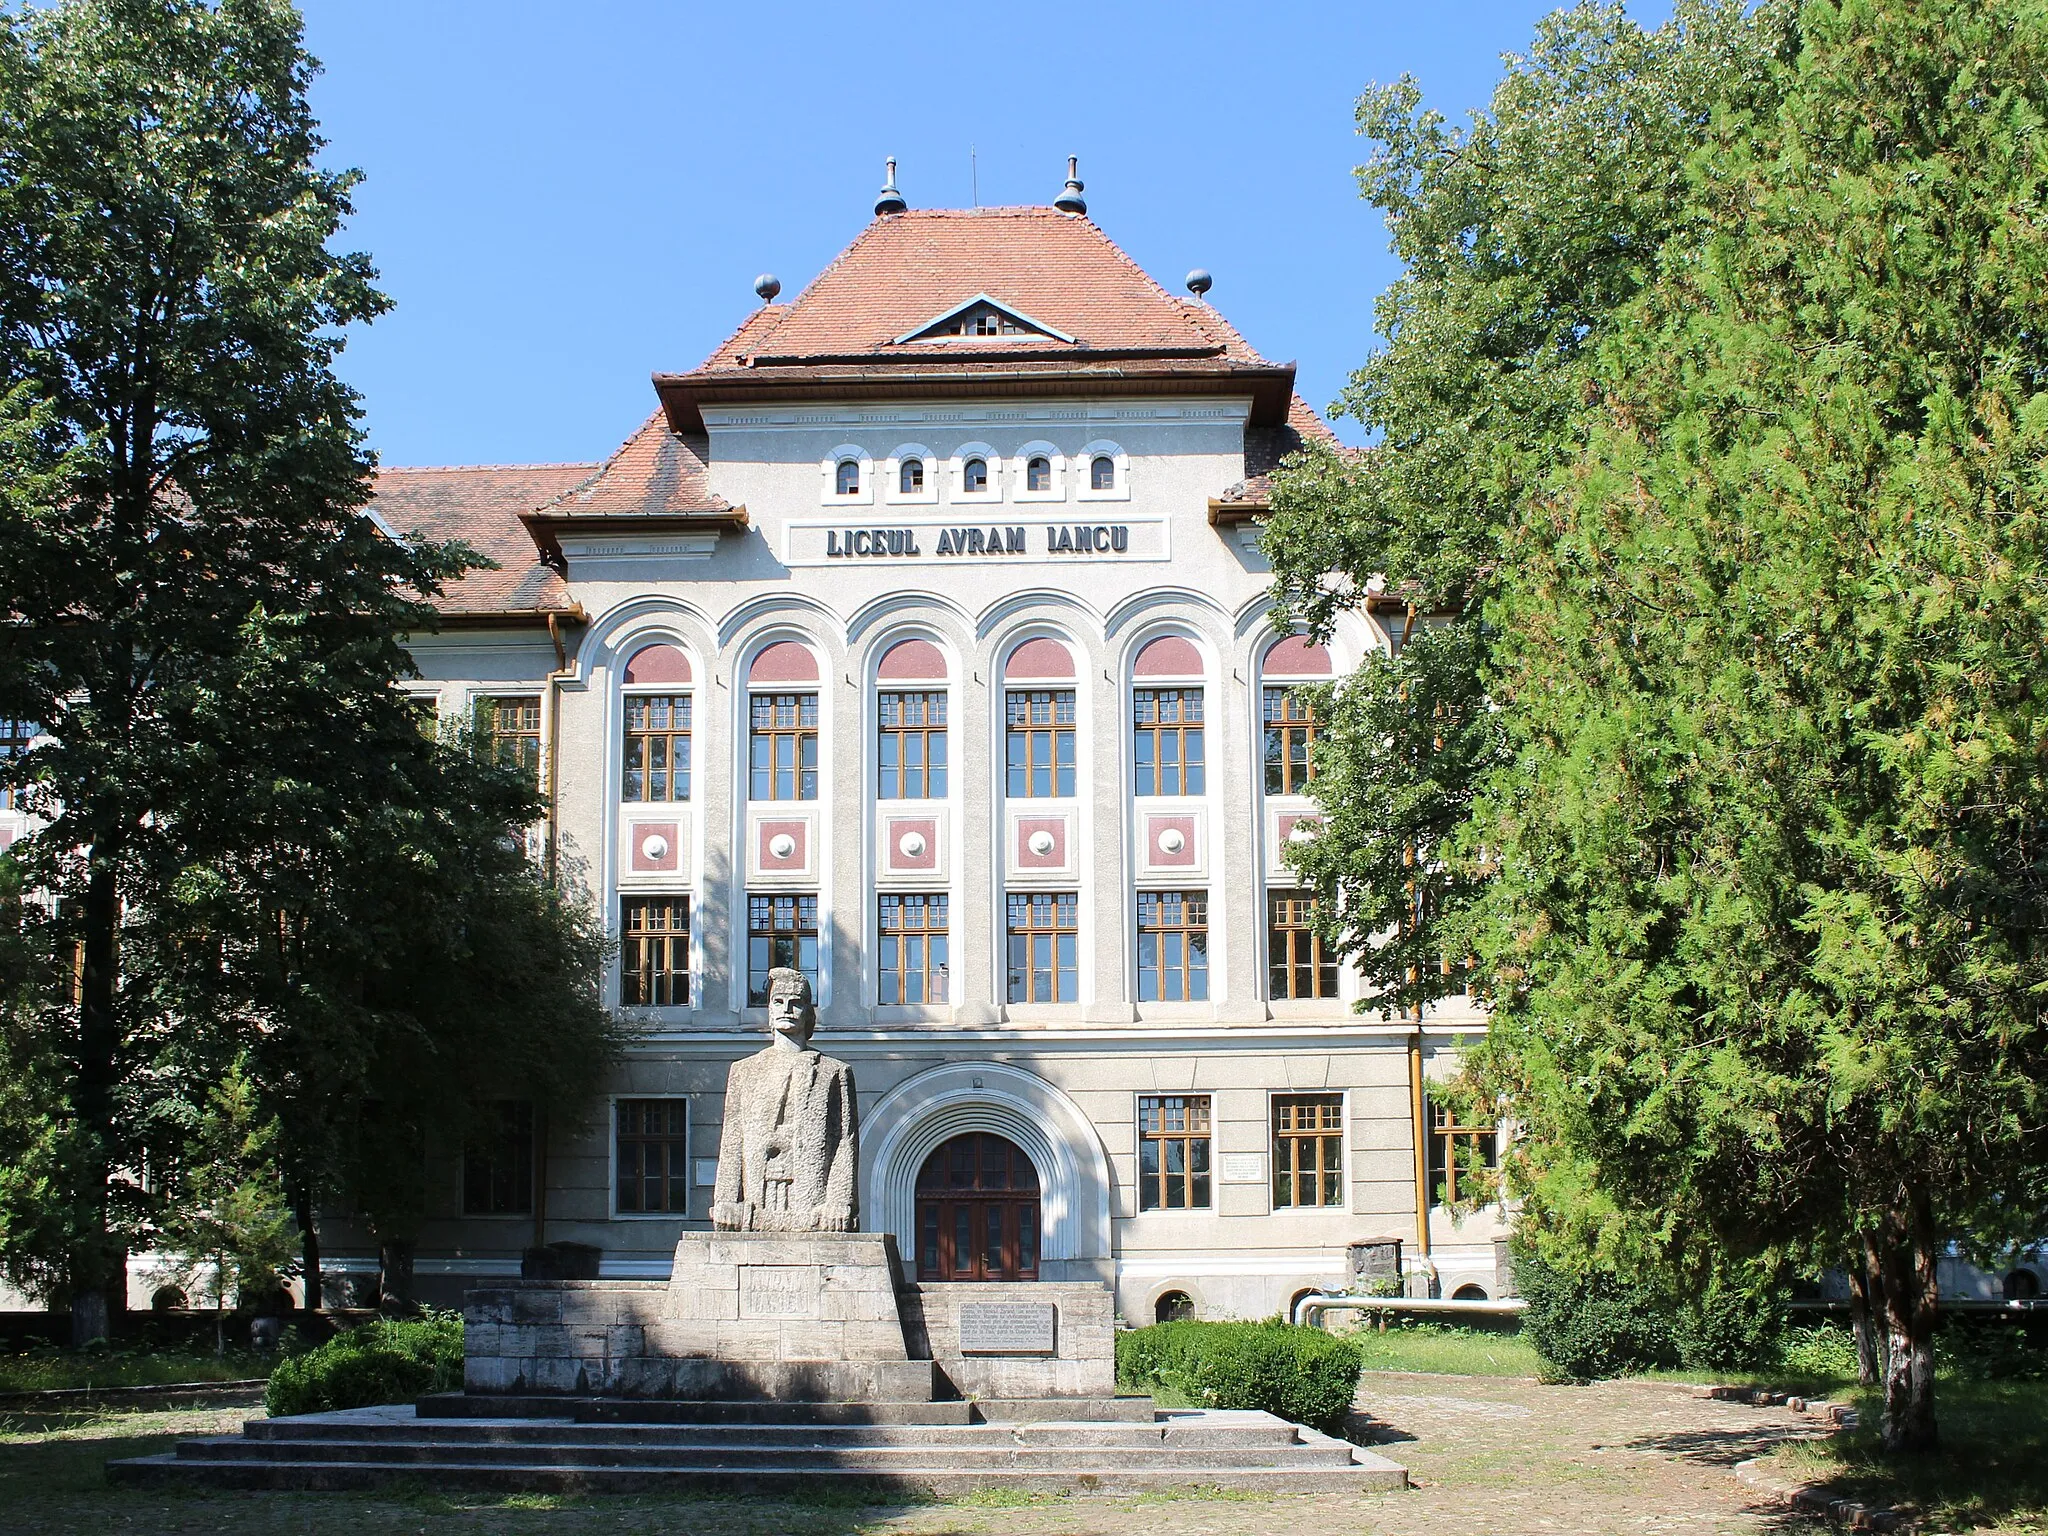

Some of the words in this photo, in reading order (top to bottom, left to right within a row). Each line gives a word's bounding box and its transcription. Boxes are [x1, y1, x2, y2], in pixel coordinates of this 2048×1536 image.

[827, 530, 920, 557] LICEUL
[936, 527, 1027, 556] AVRAM
[1047, 526, 1128, 554] IANCU
